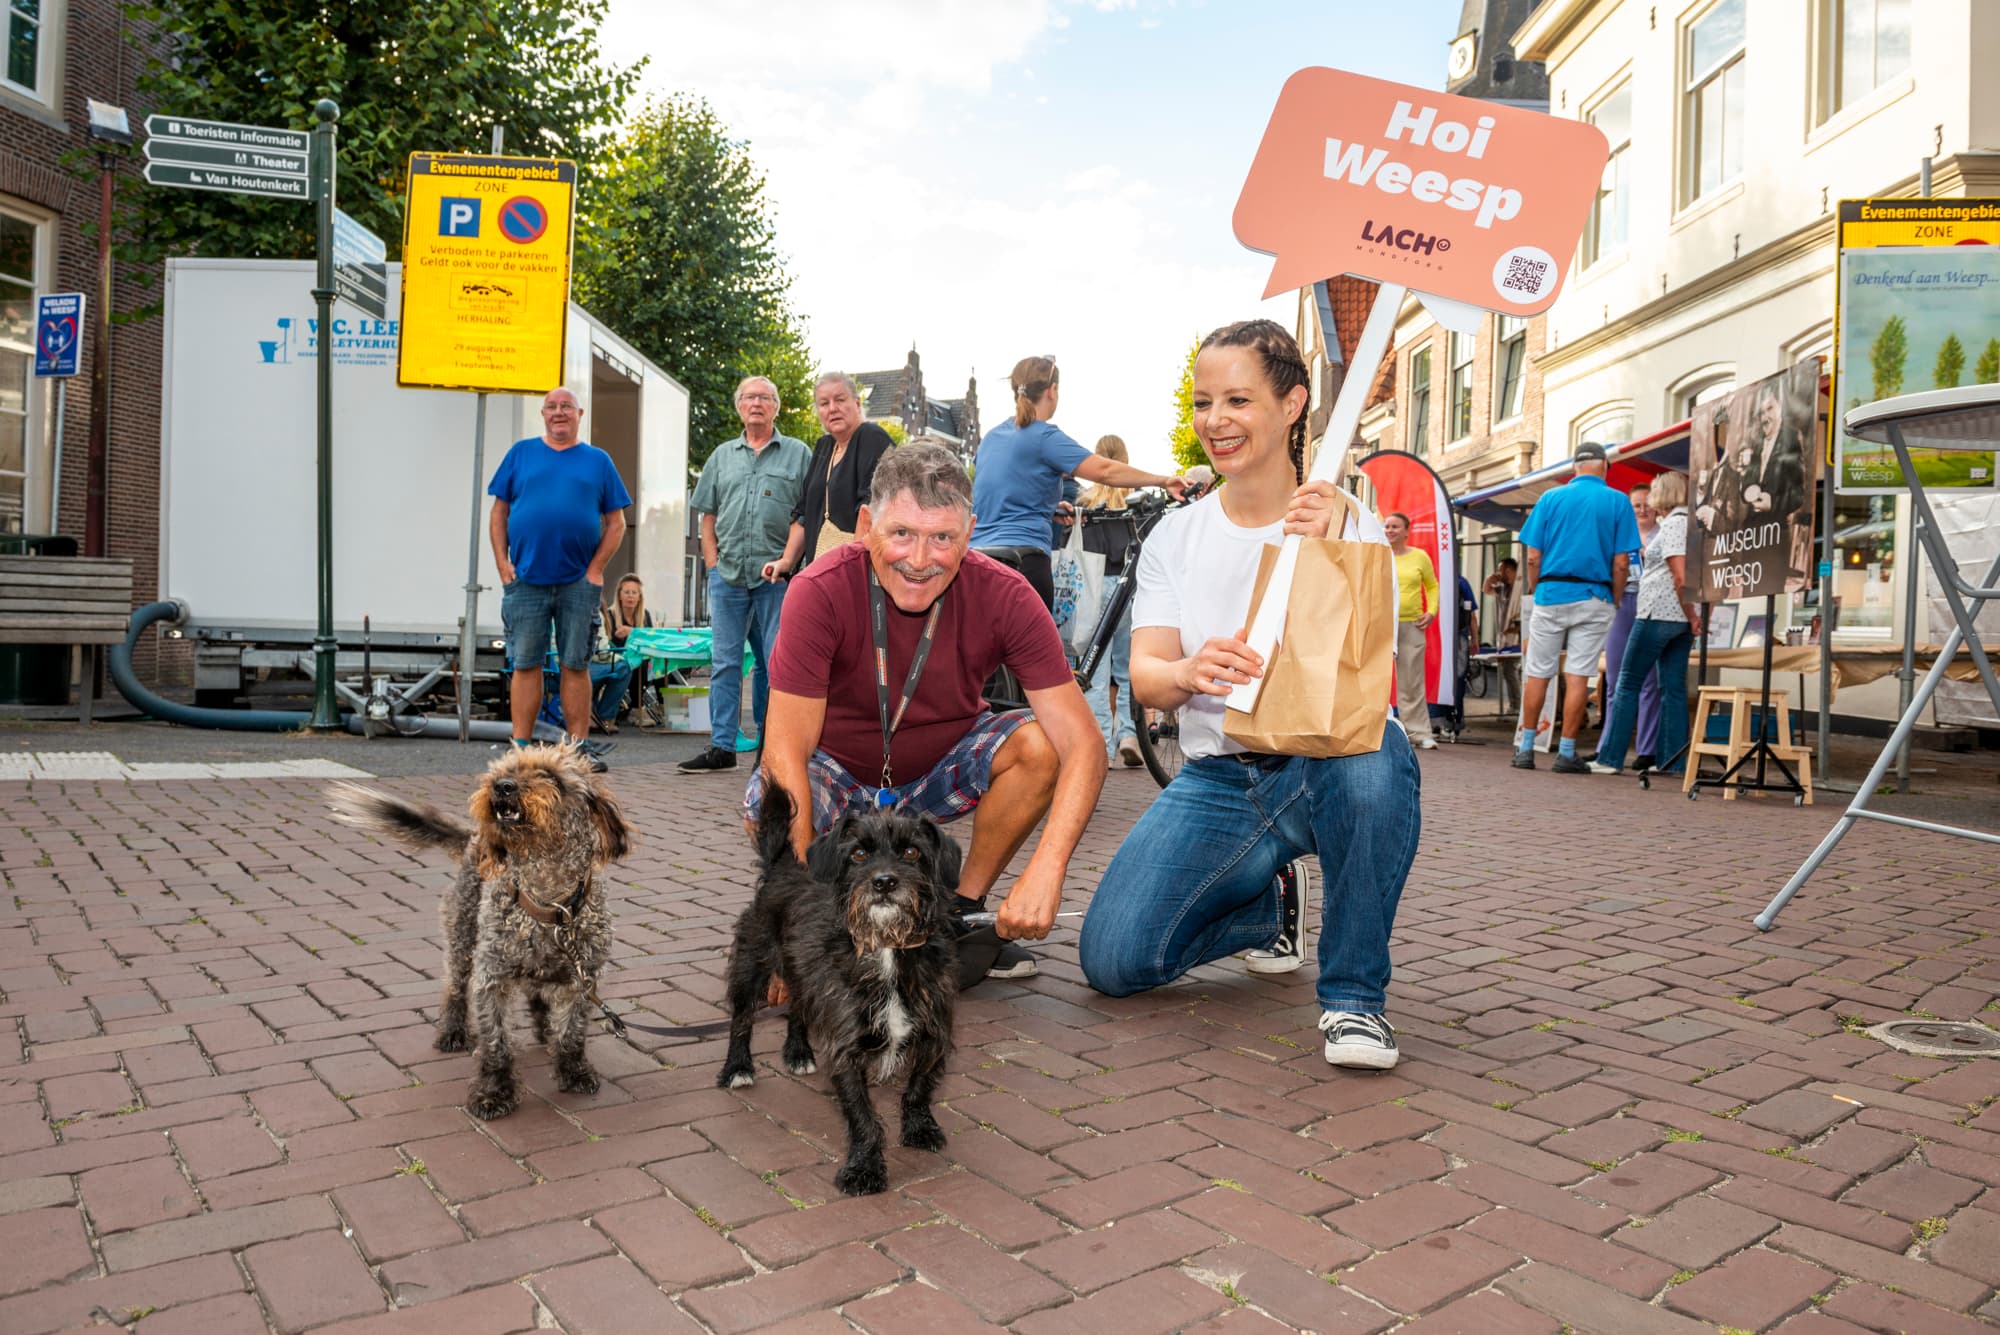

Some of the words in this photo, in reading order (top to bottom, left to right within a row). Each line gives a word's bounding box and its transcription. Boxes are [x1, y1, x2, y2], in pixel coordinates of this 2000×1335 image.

[184, 124, 238, 140] Toeristen
[240, 130, 302, 147] informatie
[1384, 100, 1496, 159] Hoi
[252, 155, 300, 170] Theater
[430, 161, 559, 180] Evenementengebied
[205, 172, 228, 185] Van
[232, 176, 300, 192] Houtenkerk
[474, 181, 510, 193] ZONE
[1323, 137, 1523, 229] Weesp
[449, 204, 473, 235] P
[1861, 204, 2000, 221] Evenementengebie
[1914, 226, 1954, 238] ZONE
[430, 245, 482, 257] Verboden
[485, 249, 496, 258] te
[500, 250, 549, 260] parkeren
[420, 256, 449, 267] Geldt
[452, 258, 472, 268] ook
[475, 261, 500, 270] voor
[503, 262, 516, 271] de
[520, 263, 558, 273] vakken
[1854, 269, 1916, 287] Denkend
[1916, 274, 1941, 284] aan
